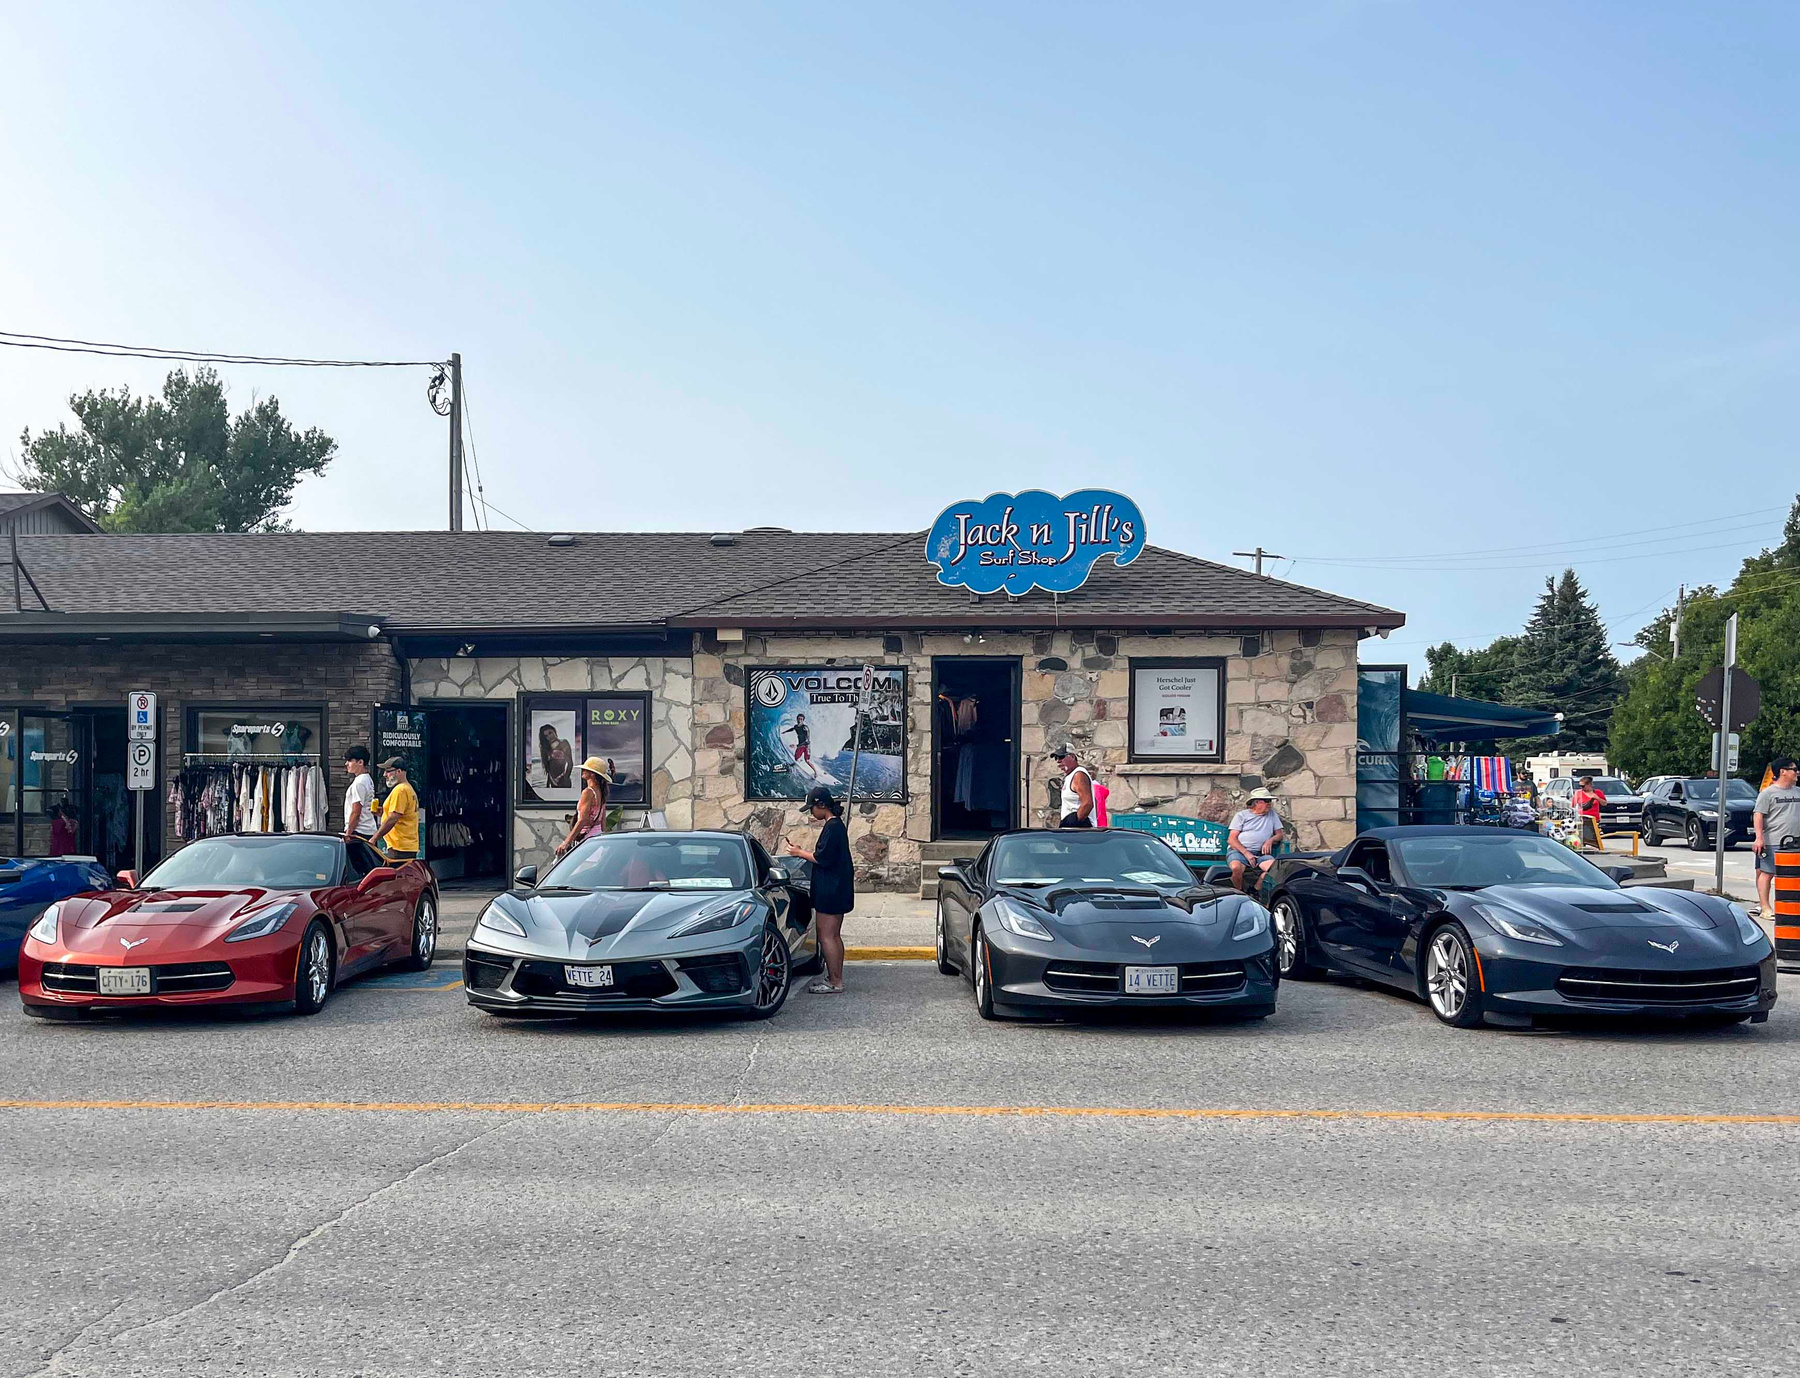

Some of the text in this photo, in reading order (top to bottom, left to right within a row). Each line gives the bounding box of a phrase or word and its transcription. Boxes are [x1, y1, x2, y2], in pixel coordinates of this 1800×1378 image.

[950, 504, 1135, 566] Jack n Jill's
[979, 550, 1058, 566] Surf Shop
[811, 693, 832, 702] True
[833, 693, 845, 702] To
[591, 709, 640, 721] ROXY
[382, 732, 421, 740] RIDICULOUSLY
[382, 739, 422, 748] COMFORTABLE
[1357, 755, 1390, 765] CURL
[134, 767, 149, 777] 2 hr
[102, 975, 148, 988] CFTY 176
[566, 969, 612, 982] VETTE 24
[1128, 973, 1176, 987] 14 VETTE
